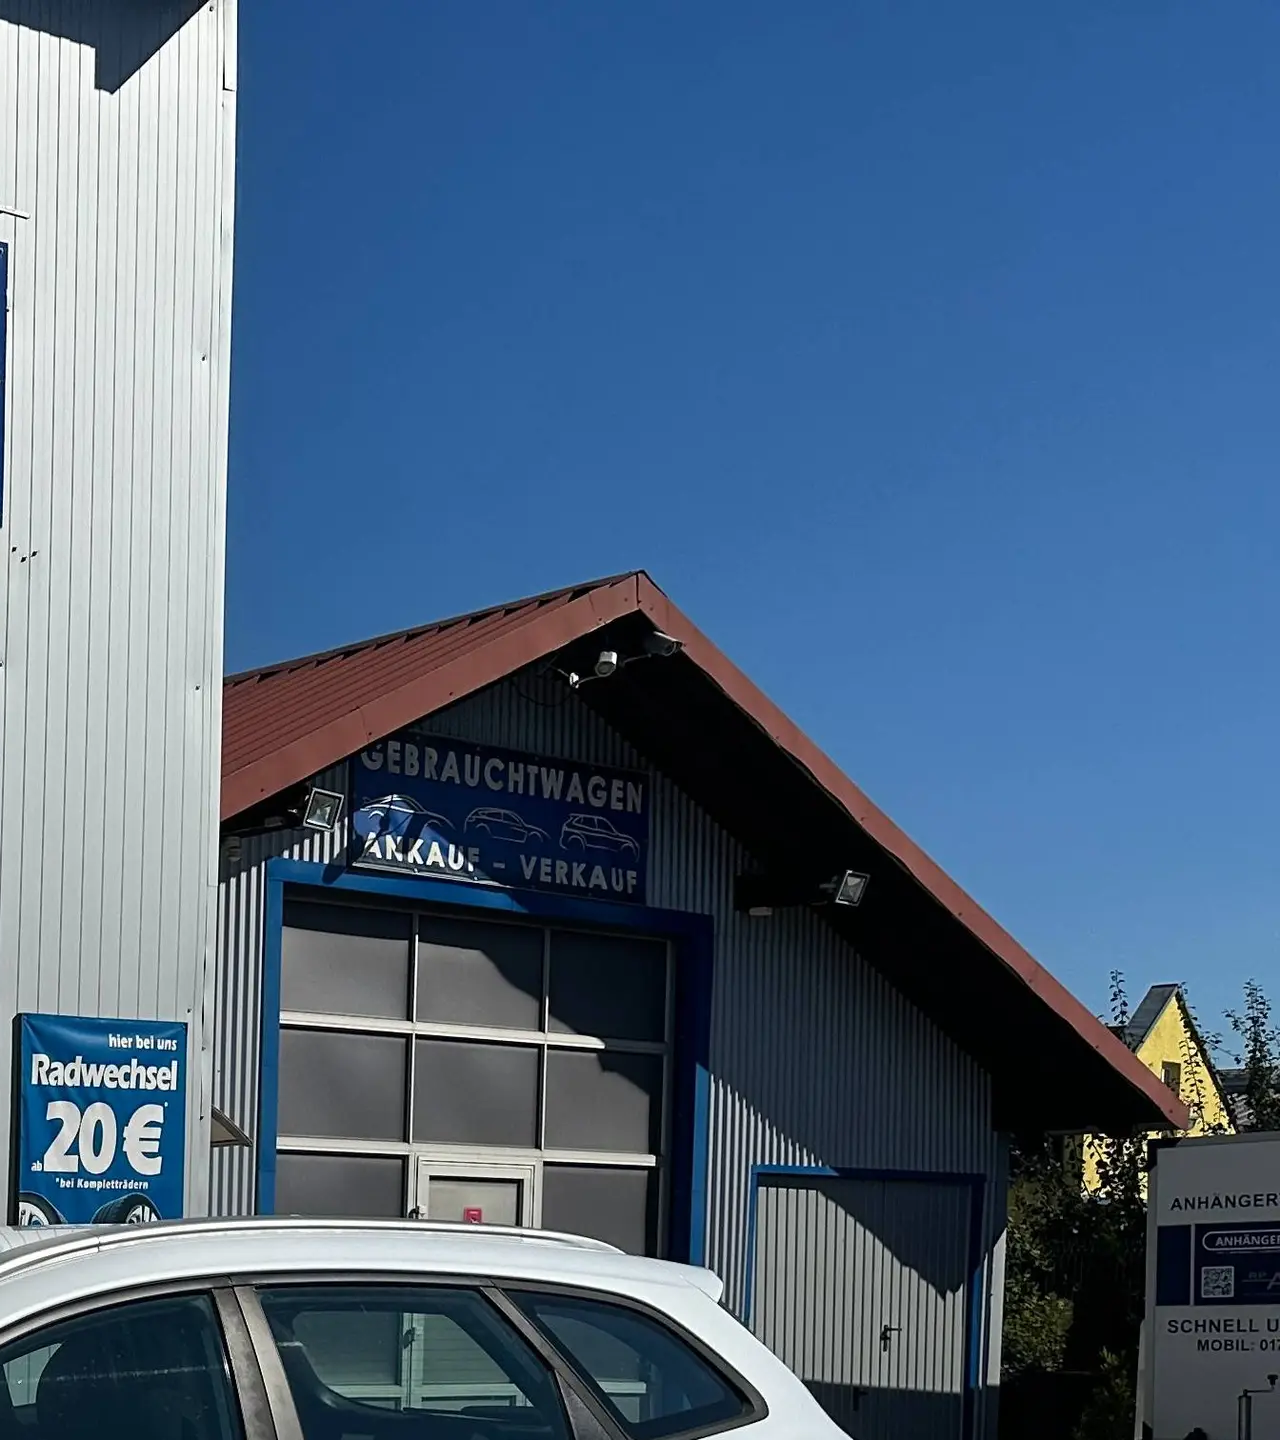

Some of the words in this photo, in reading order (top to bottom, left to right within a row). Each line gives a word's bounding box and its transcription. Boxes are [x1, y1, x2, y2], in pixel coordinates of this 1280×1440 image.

[361, 740, 643, 814] GEBRAUCHTWAGEN
[363, 831, 481, 872] ANKAUF
[519, 854, 638, 894] VERKAUF
[108, 1033, 132, 1049] hier
[136, 1034, 153, 1050] bei
[156, 1037, 178, 1051] uns
[31, 1053, 178, 1091] Radwechsel
[31, 1160, 42, 1172] ab
[76, 1177, 149, 1191] Kompletträdern
[1170, 1192, 1280, 1211] ANHÄNGER
[1167, 1318, 1259, 1333] SCHNELL
[1197, 1339, 1256, 1352] MOBIL:
